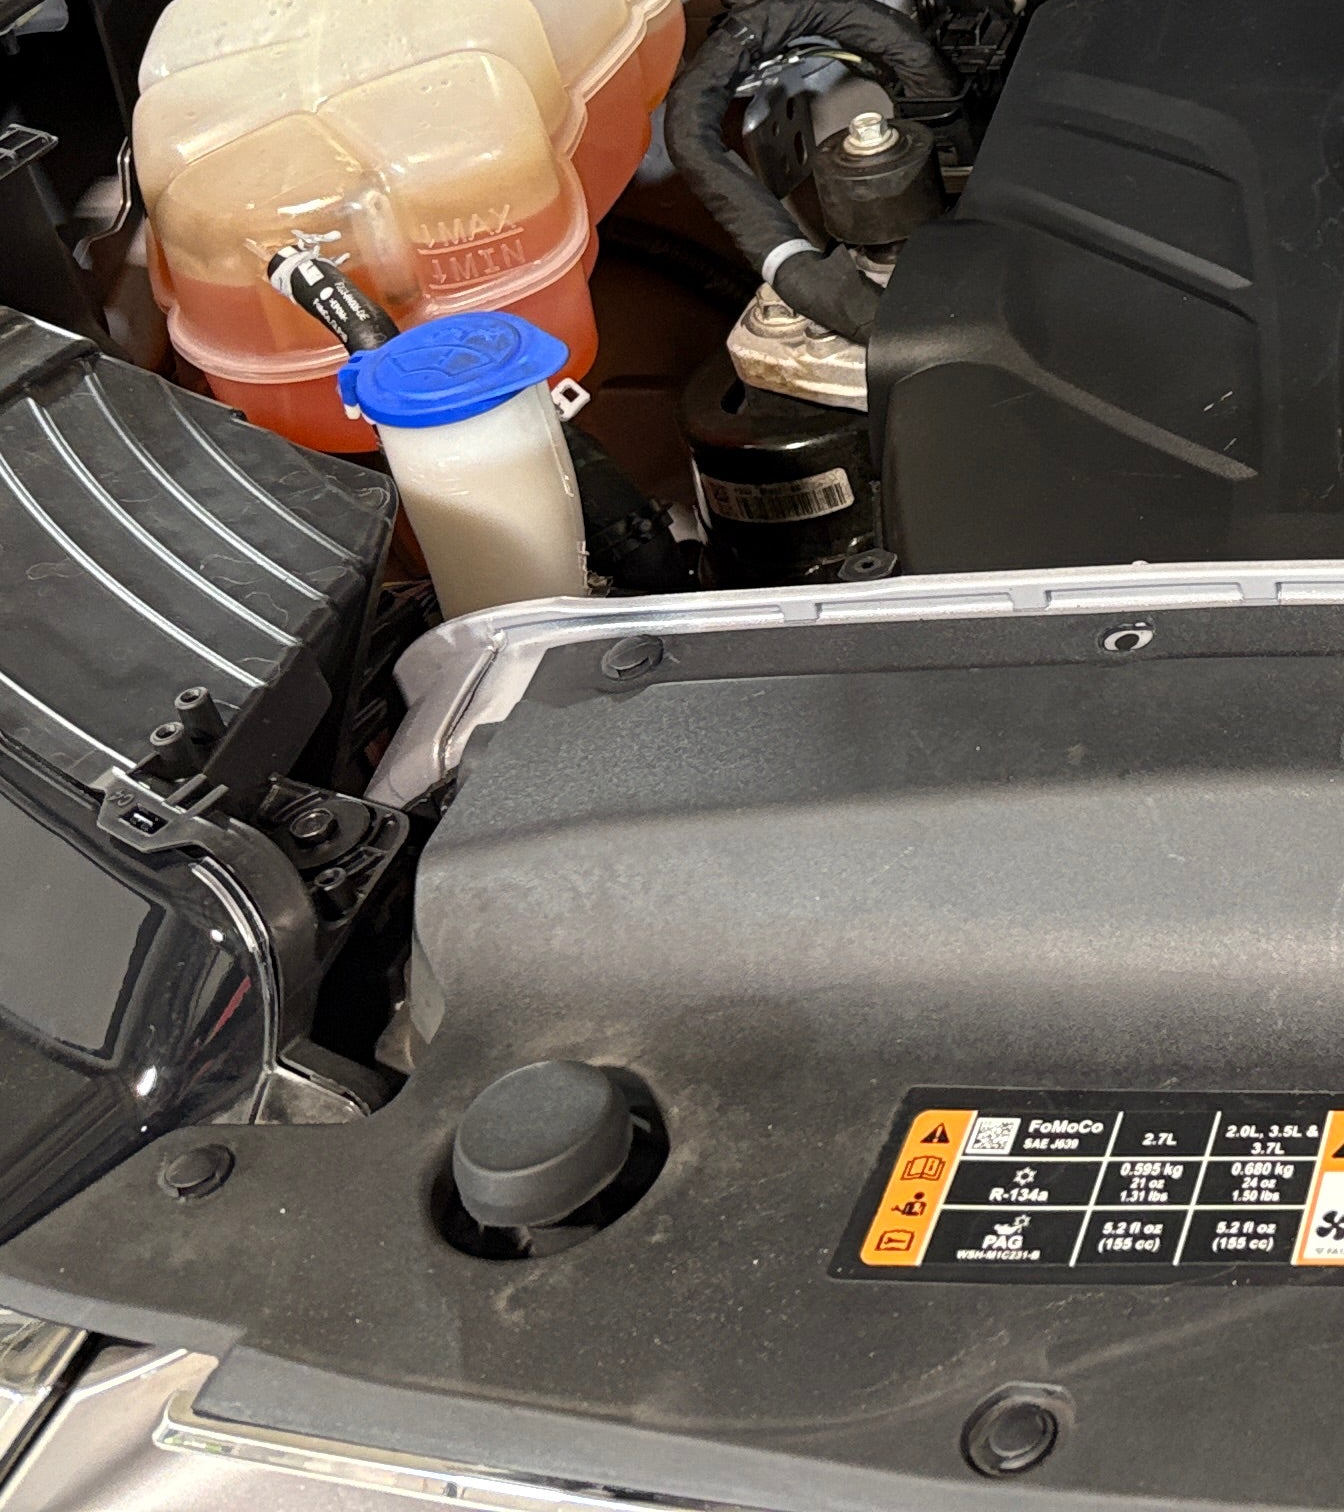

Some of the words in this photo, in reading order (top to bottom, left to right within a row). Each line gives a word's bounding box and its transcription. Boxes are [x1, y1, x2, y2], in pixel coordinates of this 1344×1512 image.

[437, 204, 516, 246] MAX
[449, 239, 525, 281] MIN
[1028, 1119, 1104, 1134] FoMoCo
[1226, 1125, 1265, 1140] 2.0L,
[1268, 1125, 1302, 1139] 3.5L
[1306, 1125, 1319, 1138] &
[1023, 1137, 1048, 1150] SAE
[1142, 1132, 1177, 1146] 2.7L
[1251, 1142, 1285, 1156] 3.7L
[1120, 1162, 1160, 1177] 0.595
[1164, 1163, 1183, 1178] kg
[1231, 1162, 1271, 1177] 0.680
[1274, 1163, 1294, 1178] kg
[1130, 1177, 1144, 1189] 21
[1147, 1179, 1165, 1190] oz
[1242, 1177, 1256, 1189] 24
[1259, 1179, 1277, 1190] oz
[989, 1188, 1048, 1202] R-134a
[1119, 1190, 1145, 1202] 1.31
[1149, 1190, 1168, 1202] lbs
[1232, 1190, 1258, 1202] 1.50
[1261, 1190, 1280, 1202] lbs
[1103, 1221, 1127, 1236] 5.2
[1129, 1221, 1143, 1236] fl
[1144, 1223, 1164, 1236] oz
[1216, 1221, 1240, 1236] 5.2
[1243, 1221, 1257, 1236] fl
[1258, 1223, 1277, 1236] oz
[982, 1234, 1023, 1250] PAG
[1098, 1236, 1130, 1252] (155
[1133, 1237, 1161, 1252] cc)
[1212, 1236, 1243, 1252] (155
[1246, 1237, 1274, 1252] cc)
